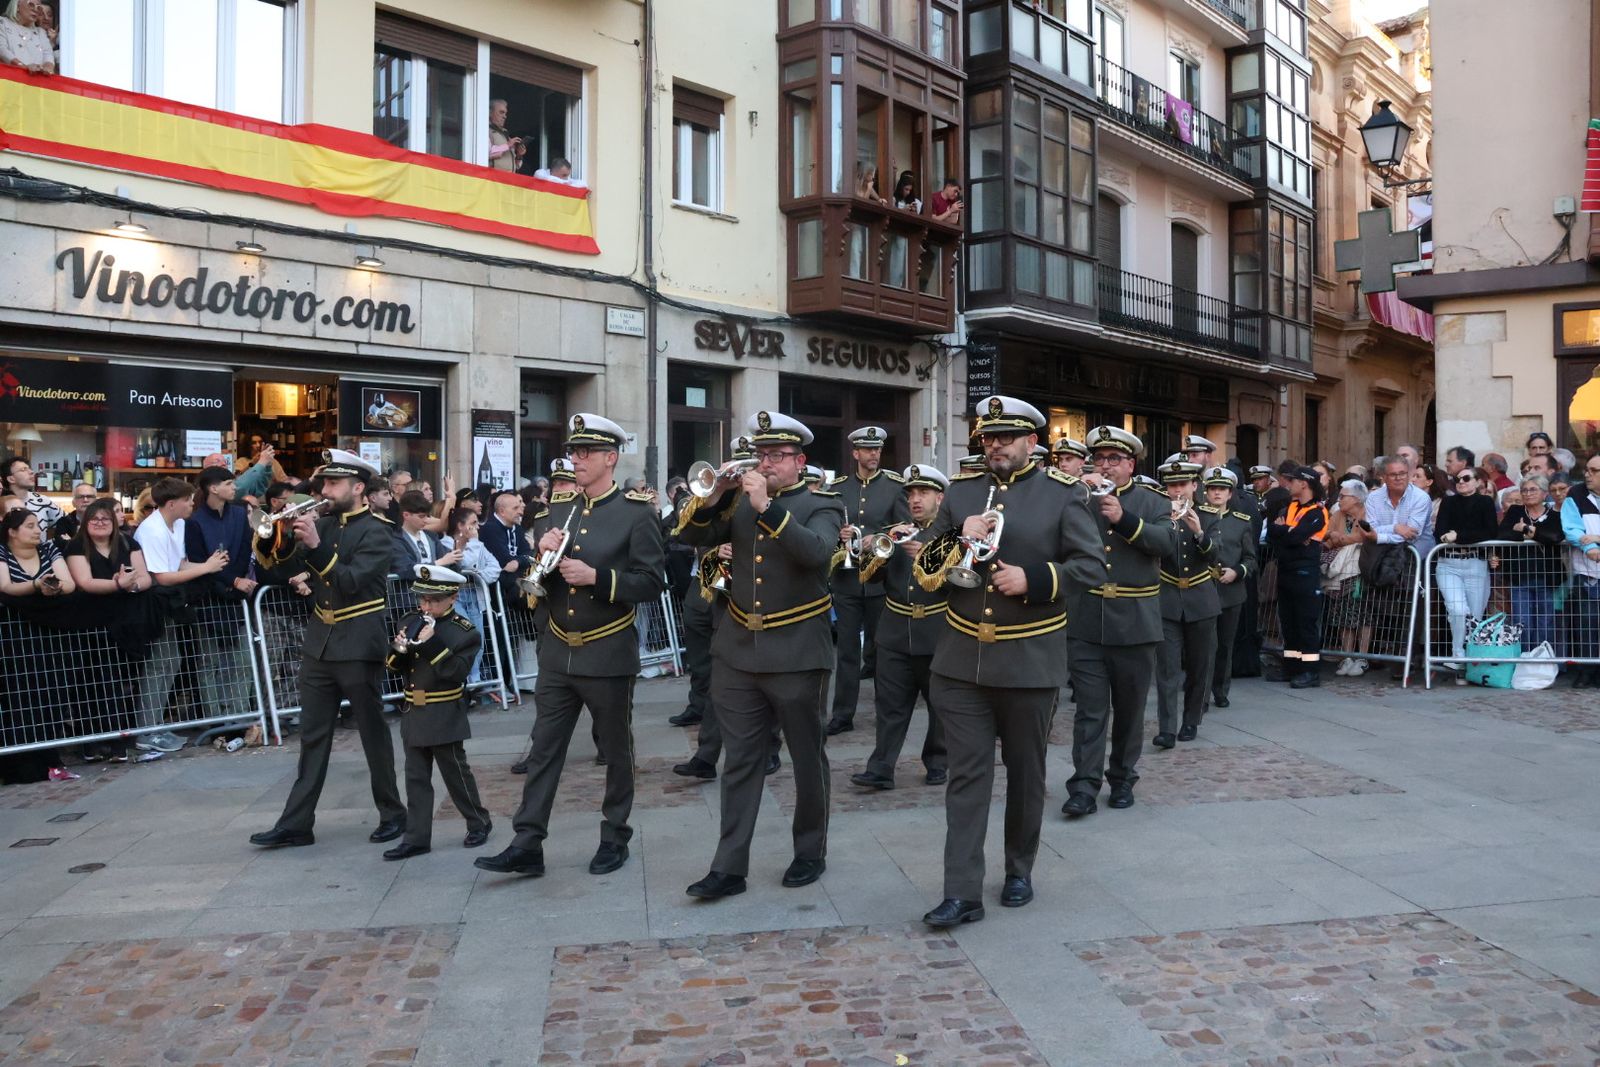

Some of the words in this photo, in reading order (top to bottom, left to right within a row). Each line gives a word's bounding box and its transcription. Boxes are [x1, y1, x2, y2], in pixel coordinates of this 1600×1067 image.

[56, 247, 415, 334] Vinodotoro.com
[694, 317, 787, 360] SEVER
[807, 336, 910, 375] SEGUROS
[16, 385, 106, 402] Vinodotoro.com
[130, 390, 156, 405] Pan
[161, 392, 223, 409] Artesano
